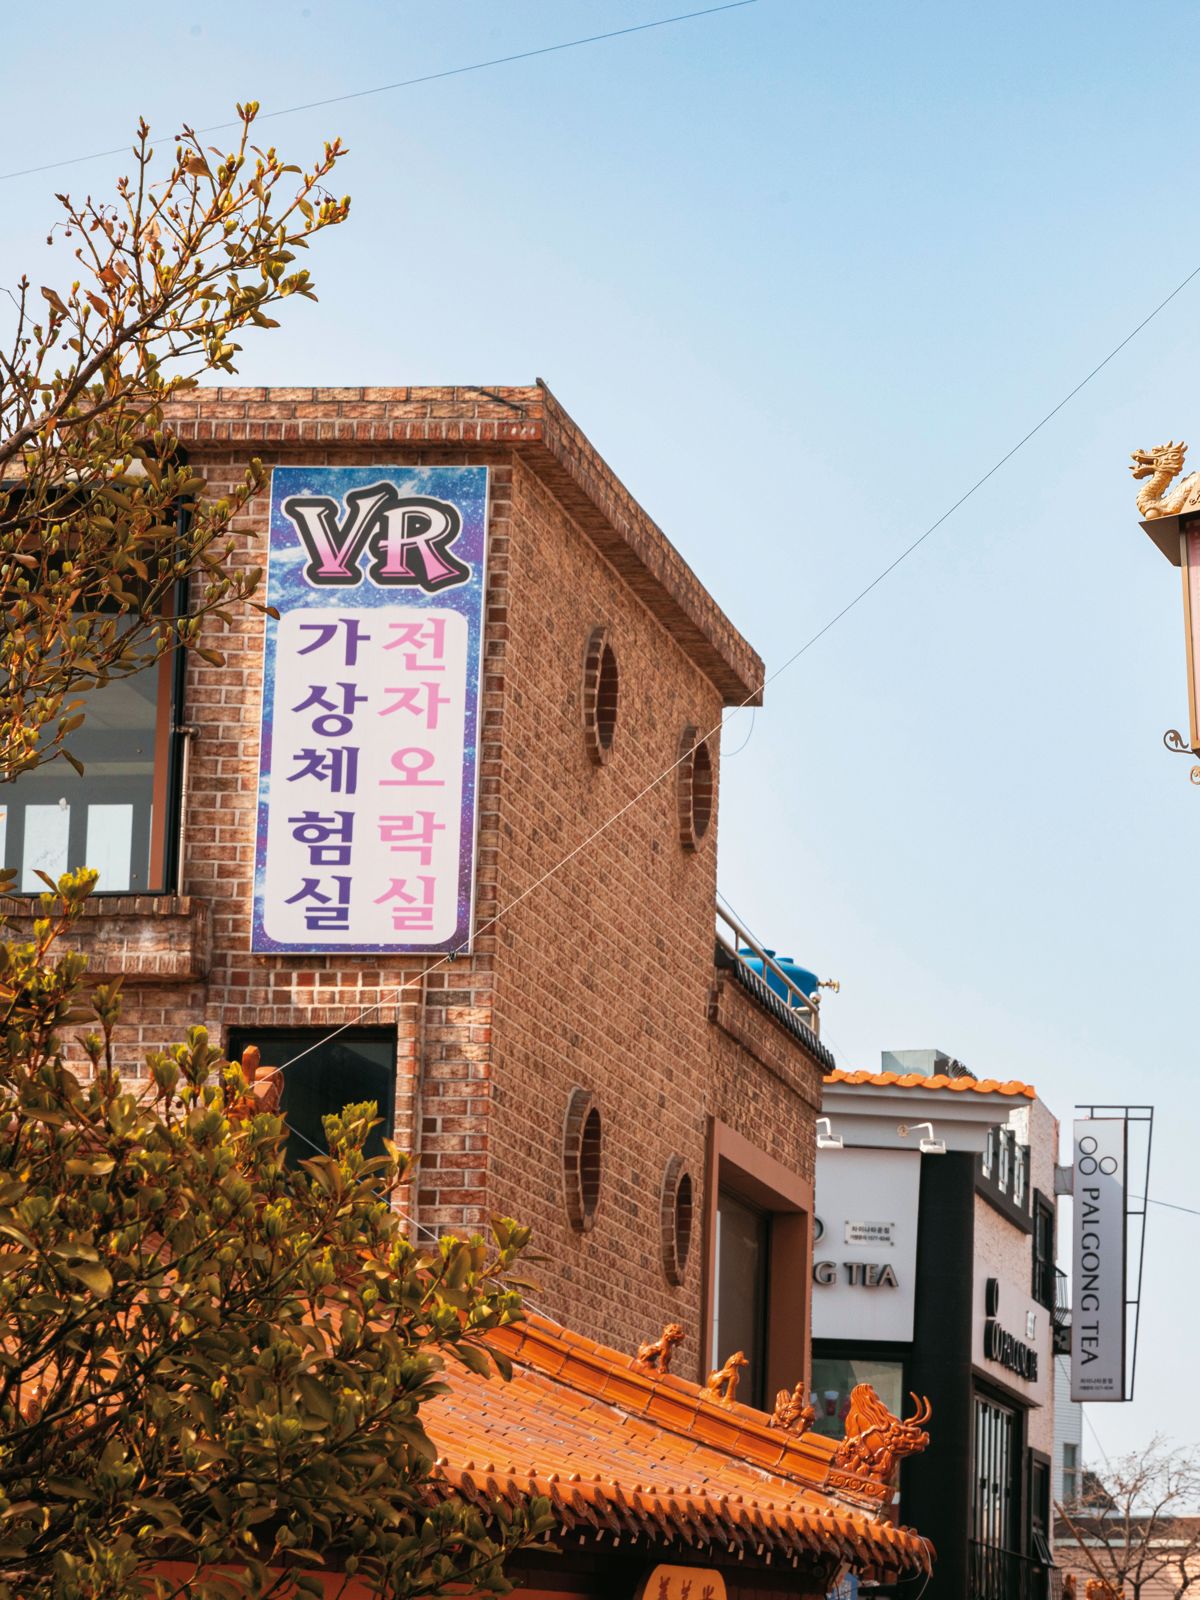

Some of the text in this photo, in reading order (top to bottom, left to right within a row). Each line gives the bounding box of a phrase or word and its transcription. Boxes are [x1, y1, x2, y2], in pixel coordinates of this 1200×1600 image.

[284, 481, 470, 591] VR
[284, 617, 371, 932] 가상체험실
[373, 617, 450, 932] 전자오락실
[843, 1262, 899, 1288] TEA
[1081, 1187, 1100, 1312] PALGONG
[1081, 1321, 1099, 1366] TEA
